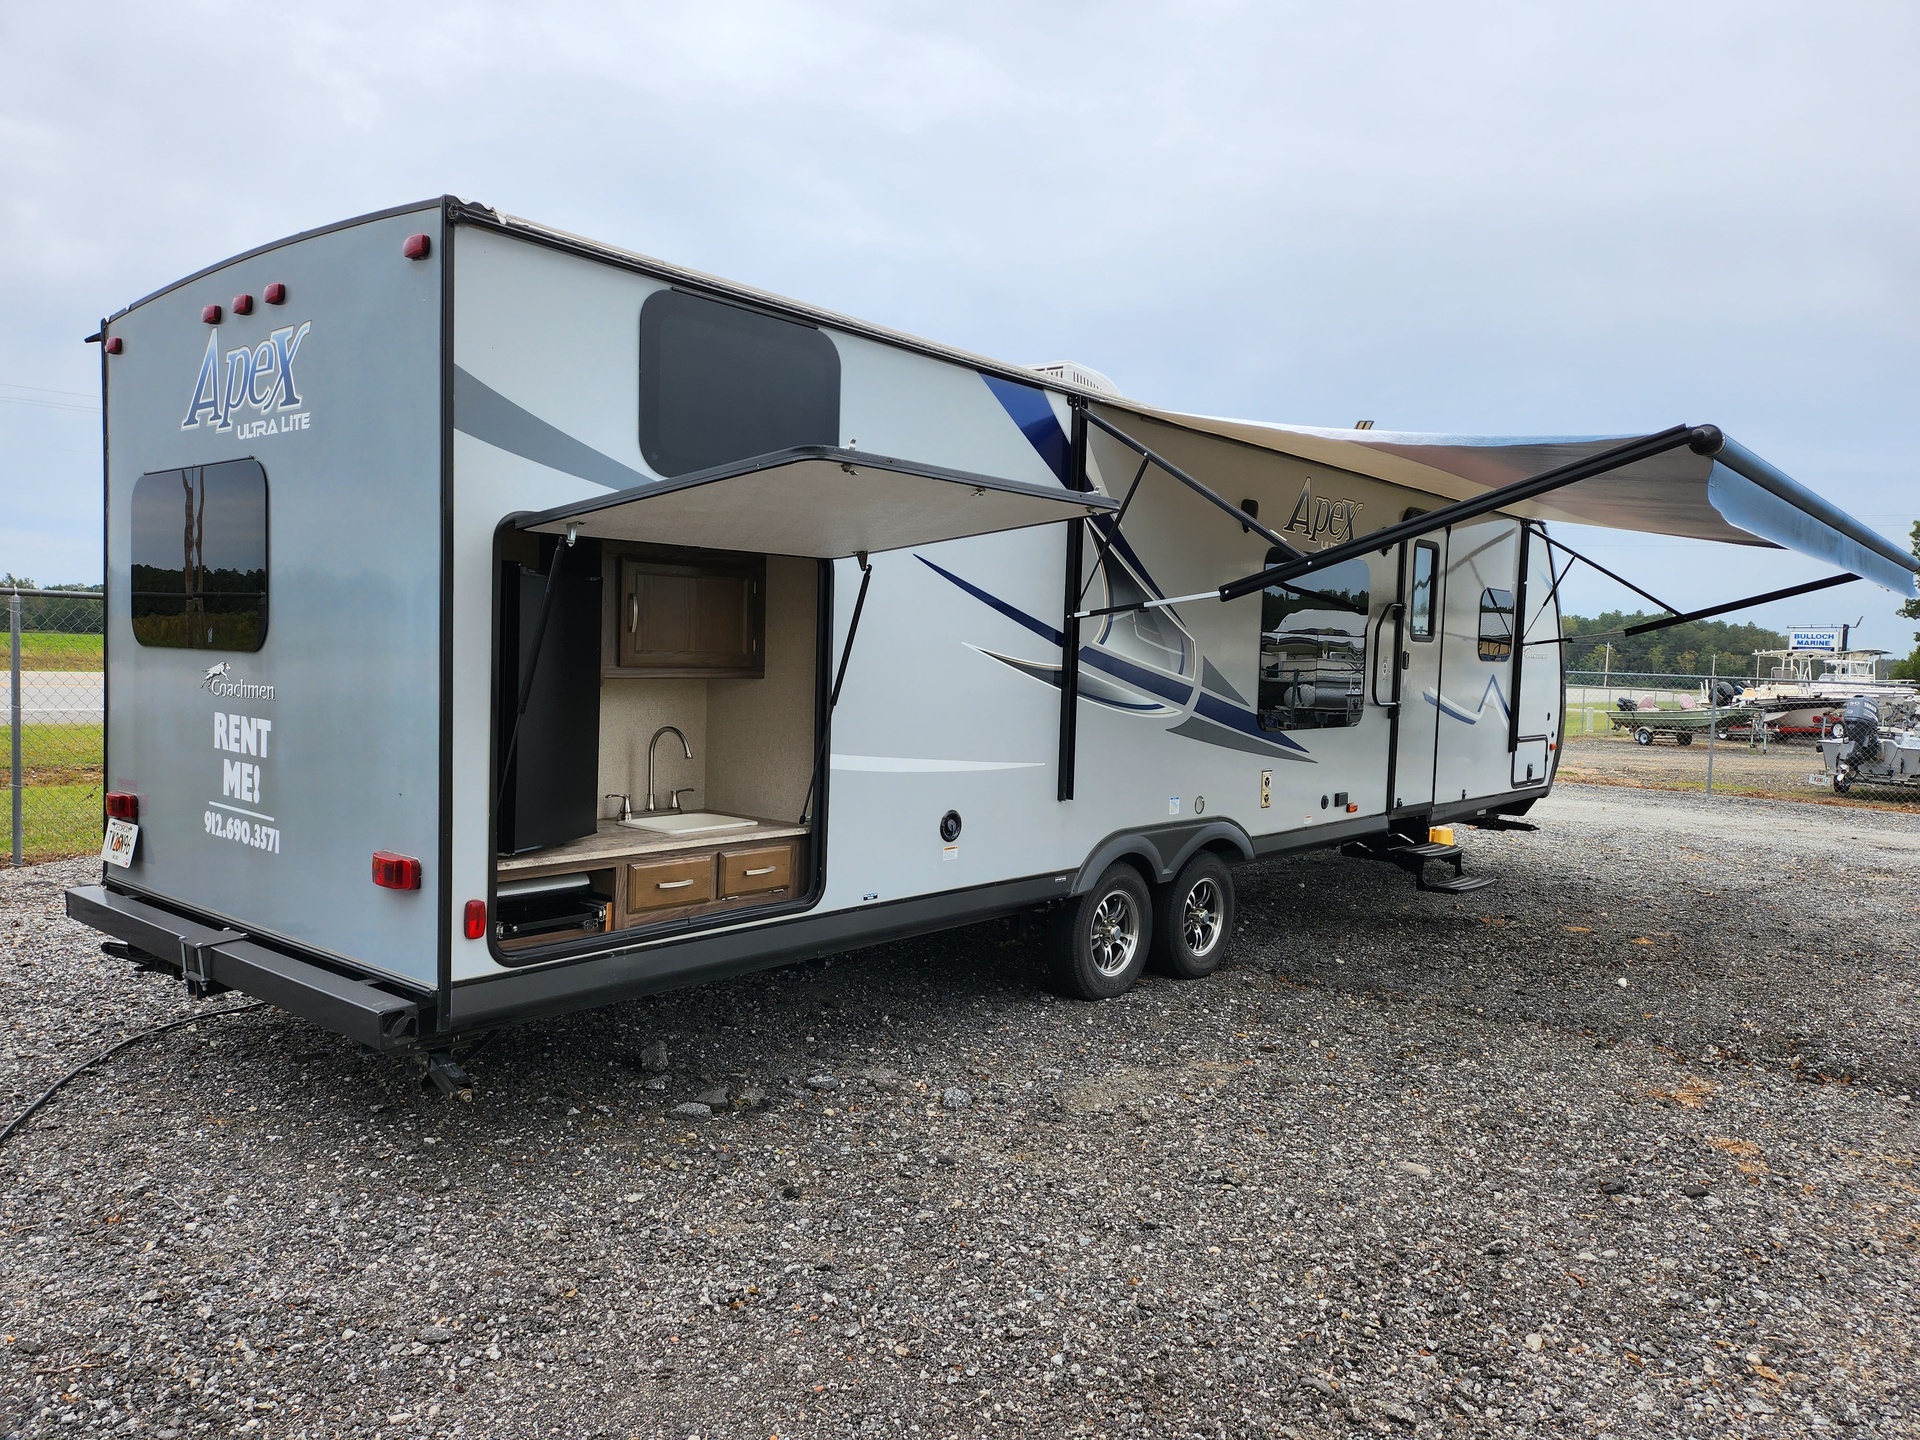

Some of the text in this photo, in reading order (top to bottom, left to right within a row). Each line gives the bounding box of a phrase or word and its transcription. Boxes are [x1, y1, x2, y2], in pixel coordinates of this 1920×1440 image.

[237, 412, 311, 440] ULTRA LITE
[211, 679, 277, 701] Coachmen
[213, 711, 272, 758] RENT
[223, 758, 261, 804] ME!
[204, 810, 280, 855] 912.690.3571
